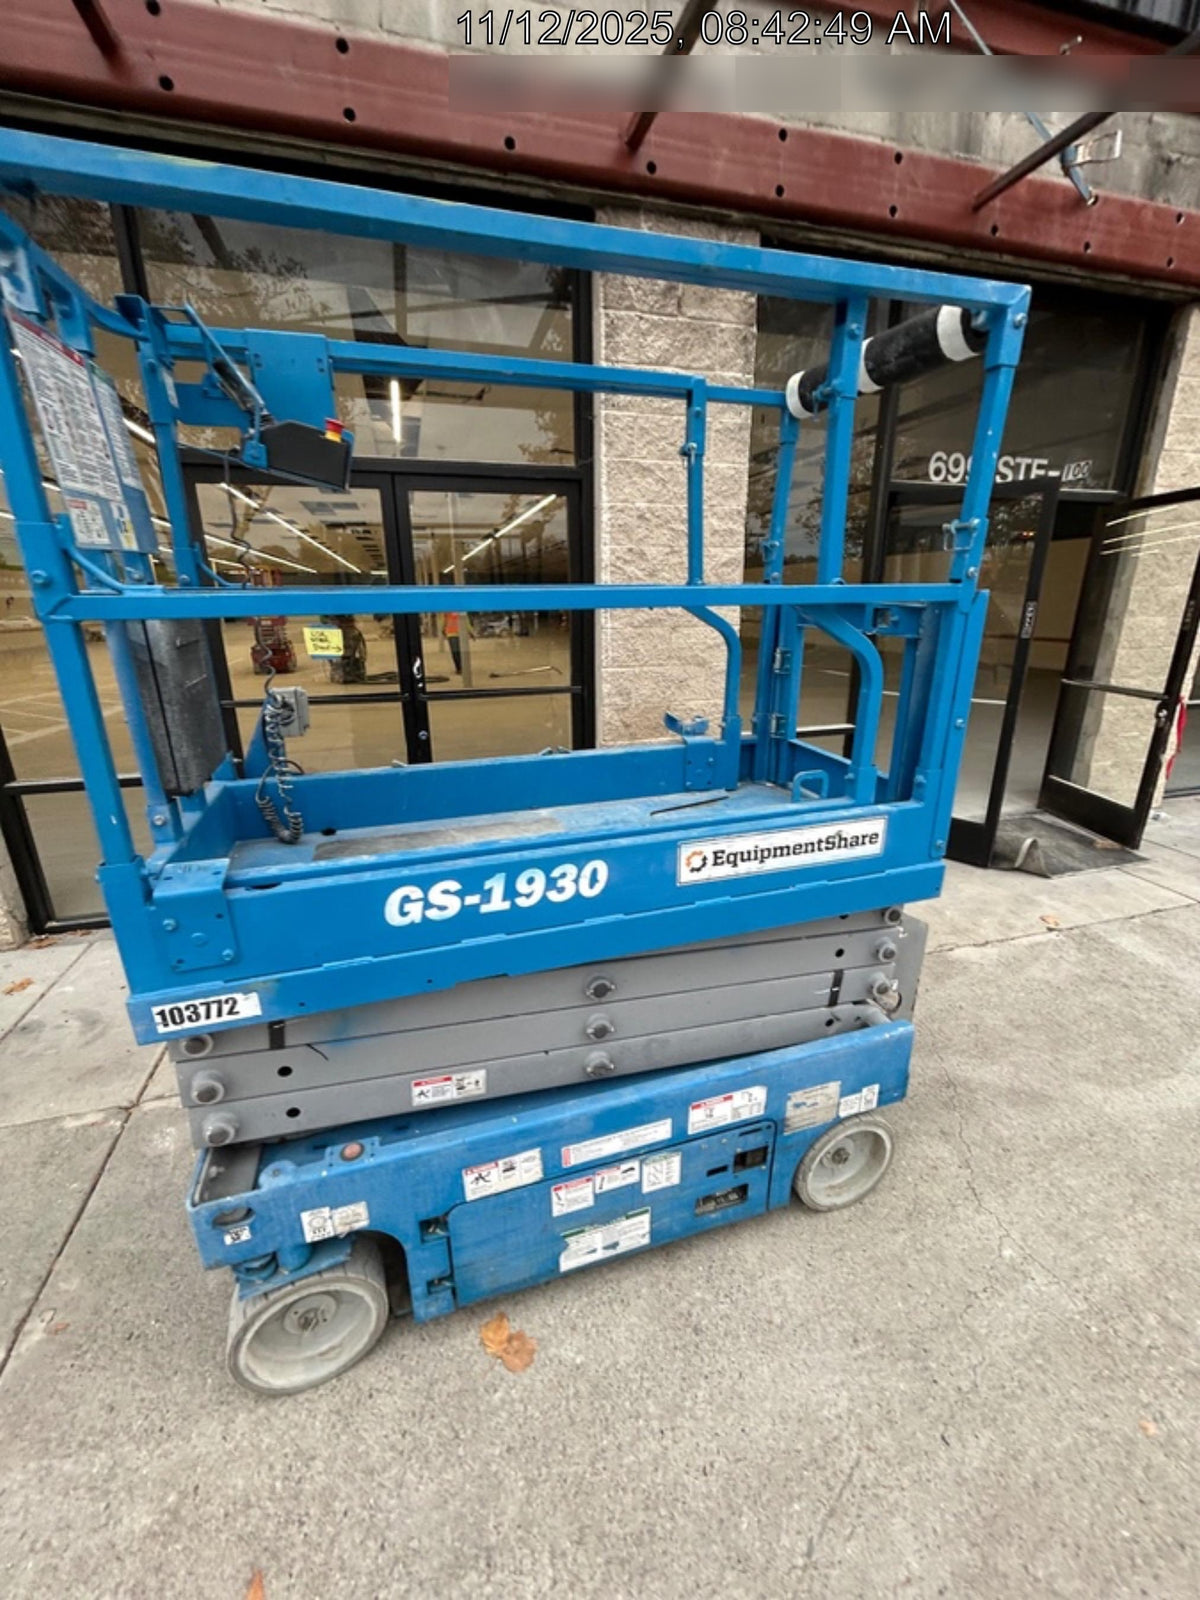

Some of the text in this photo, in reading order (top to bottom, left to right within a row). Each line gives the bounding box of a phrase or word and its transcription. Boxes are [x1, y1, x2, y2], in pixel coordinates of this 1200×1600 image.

[928, 451, 973, 484] 69
[710, 831, 880, 870] EquipmentShare
[384, 859, 610, 928] GS-1930
[155, 997, 241, 1028] 103772
